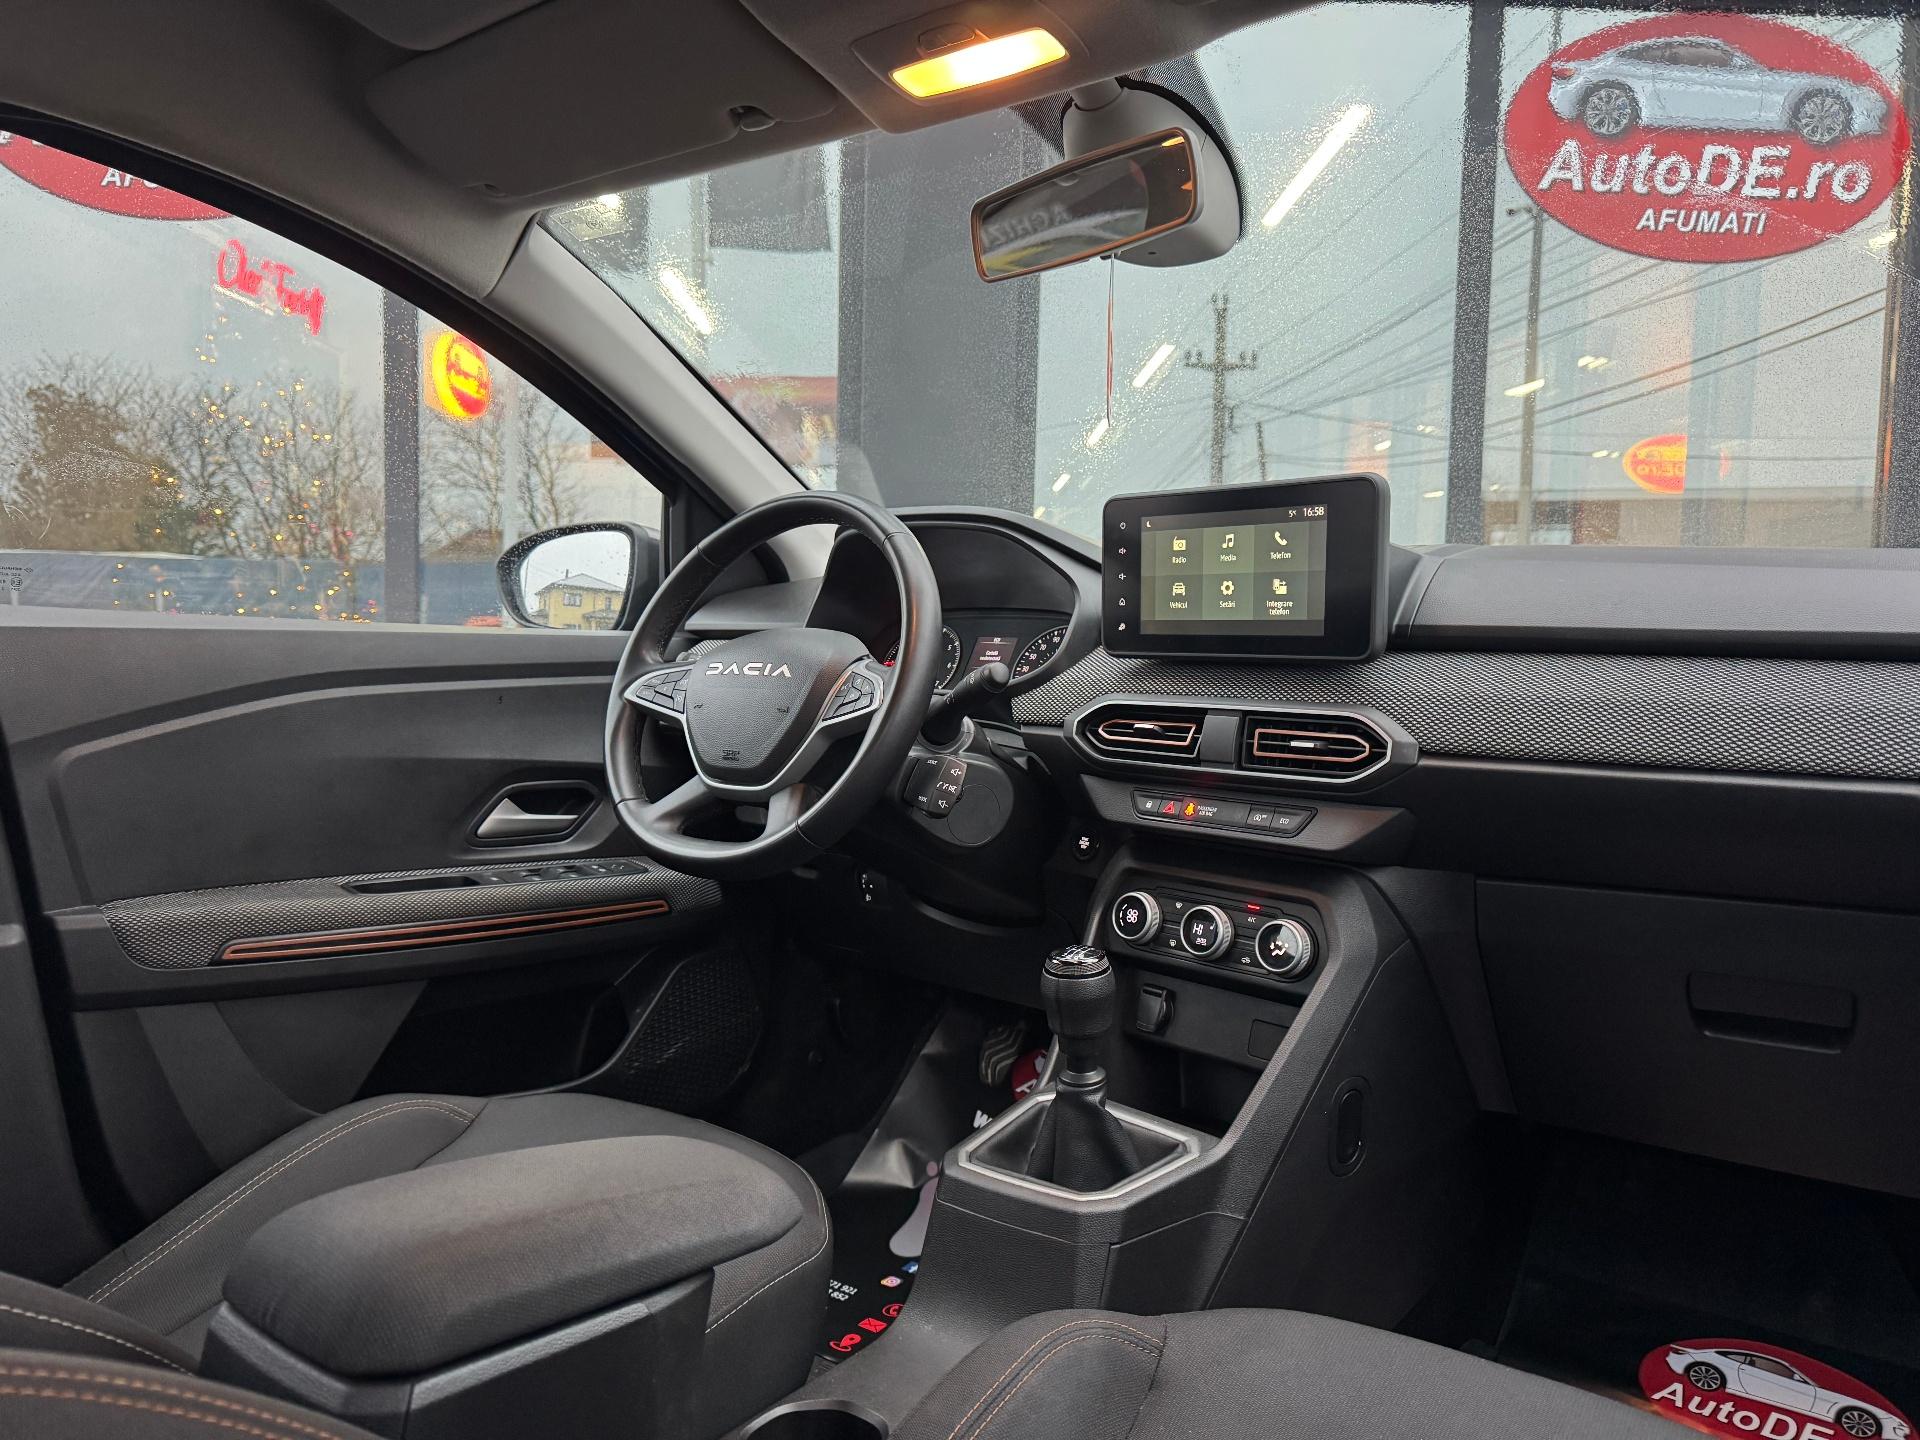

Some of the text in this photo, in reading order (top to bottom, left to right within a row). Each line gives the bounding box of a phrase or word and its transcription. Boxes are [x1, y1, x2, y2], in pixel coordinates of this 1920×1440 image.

[1537, 138, 1873, 204] AutoDE.ro
[1636, 208, 1767, 235] AFUMATI
[1303, 506, 1325, 517] 16:58
[1171, 556, 1187, 564] Radio
[1220, 554, 1237, 562] Media
[1270, 551, 1292, 560] Telefon
[1169, 601, 1188, 609] Vehicul
[1266, 600, 1294, 609] Integrare
[1269, 607, 1290, 616] telefon
[705, 661, 792, 678] DACIA
[1279, 817, 1290, 825] ECO
